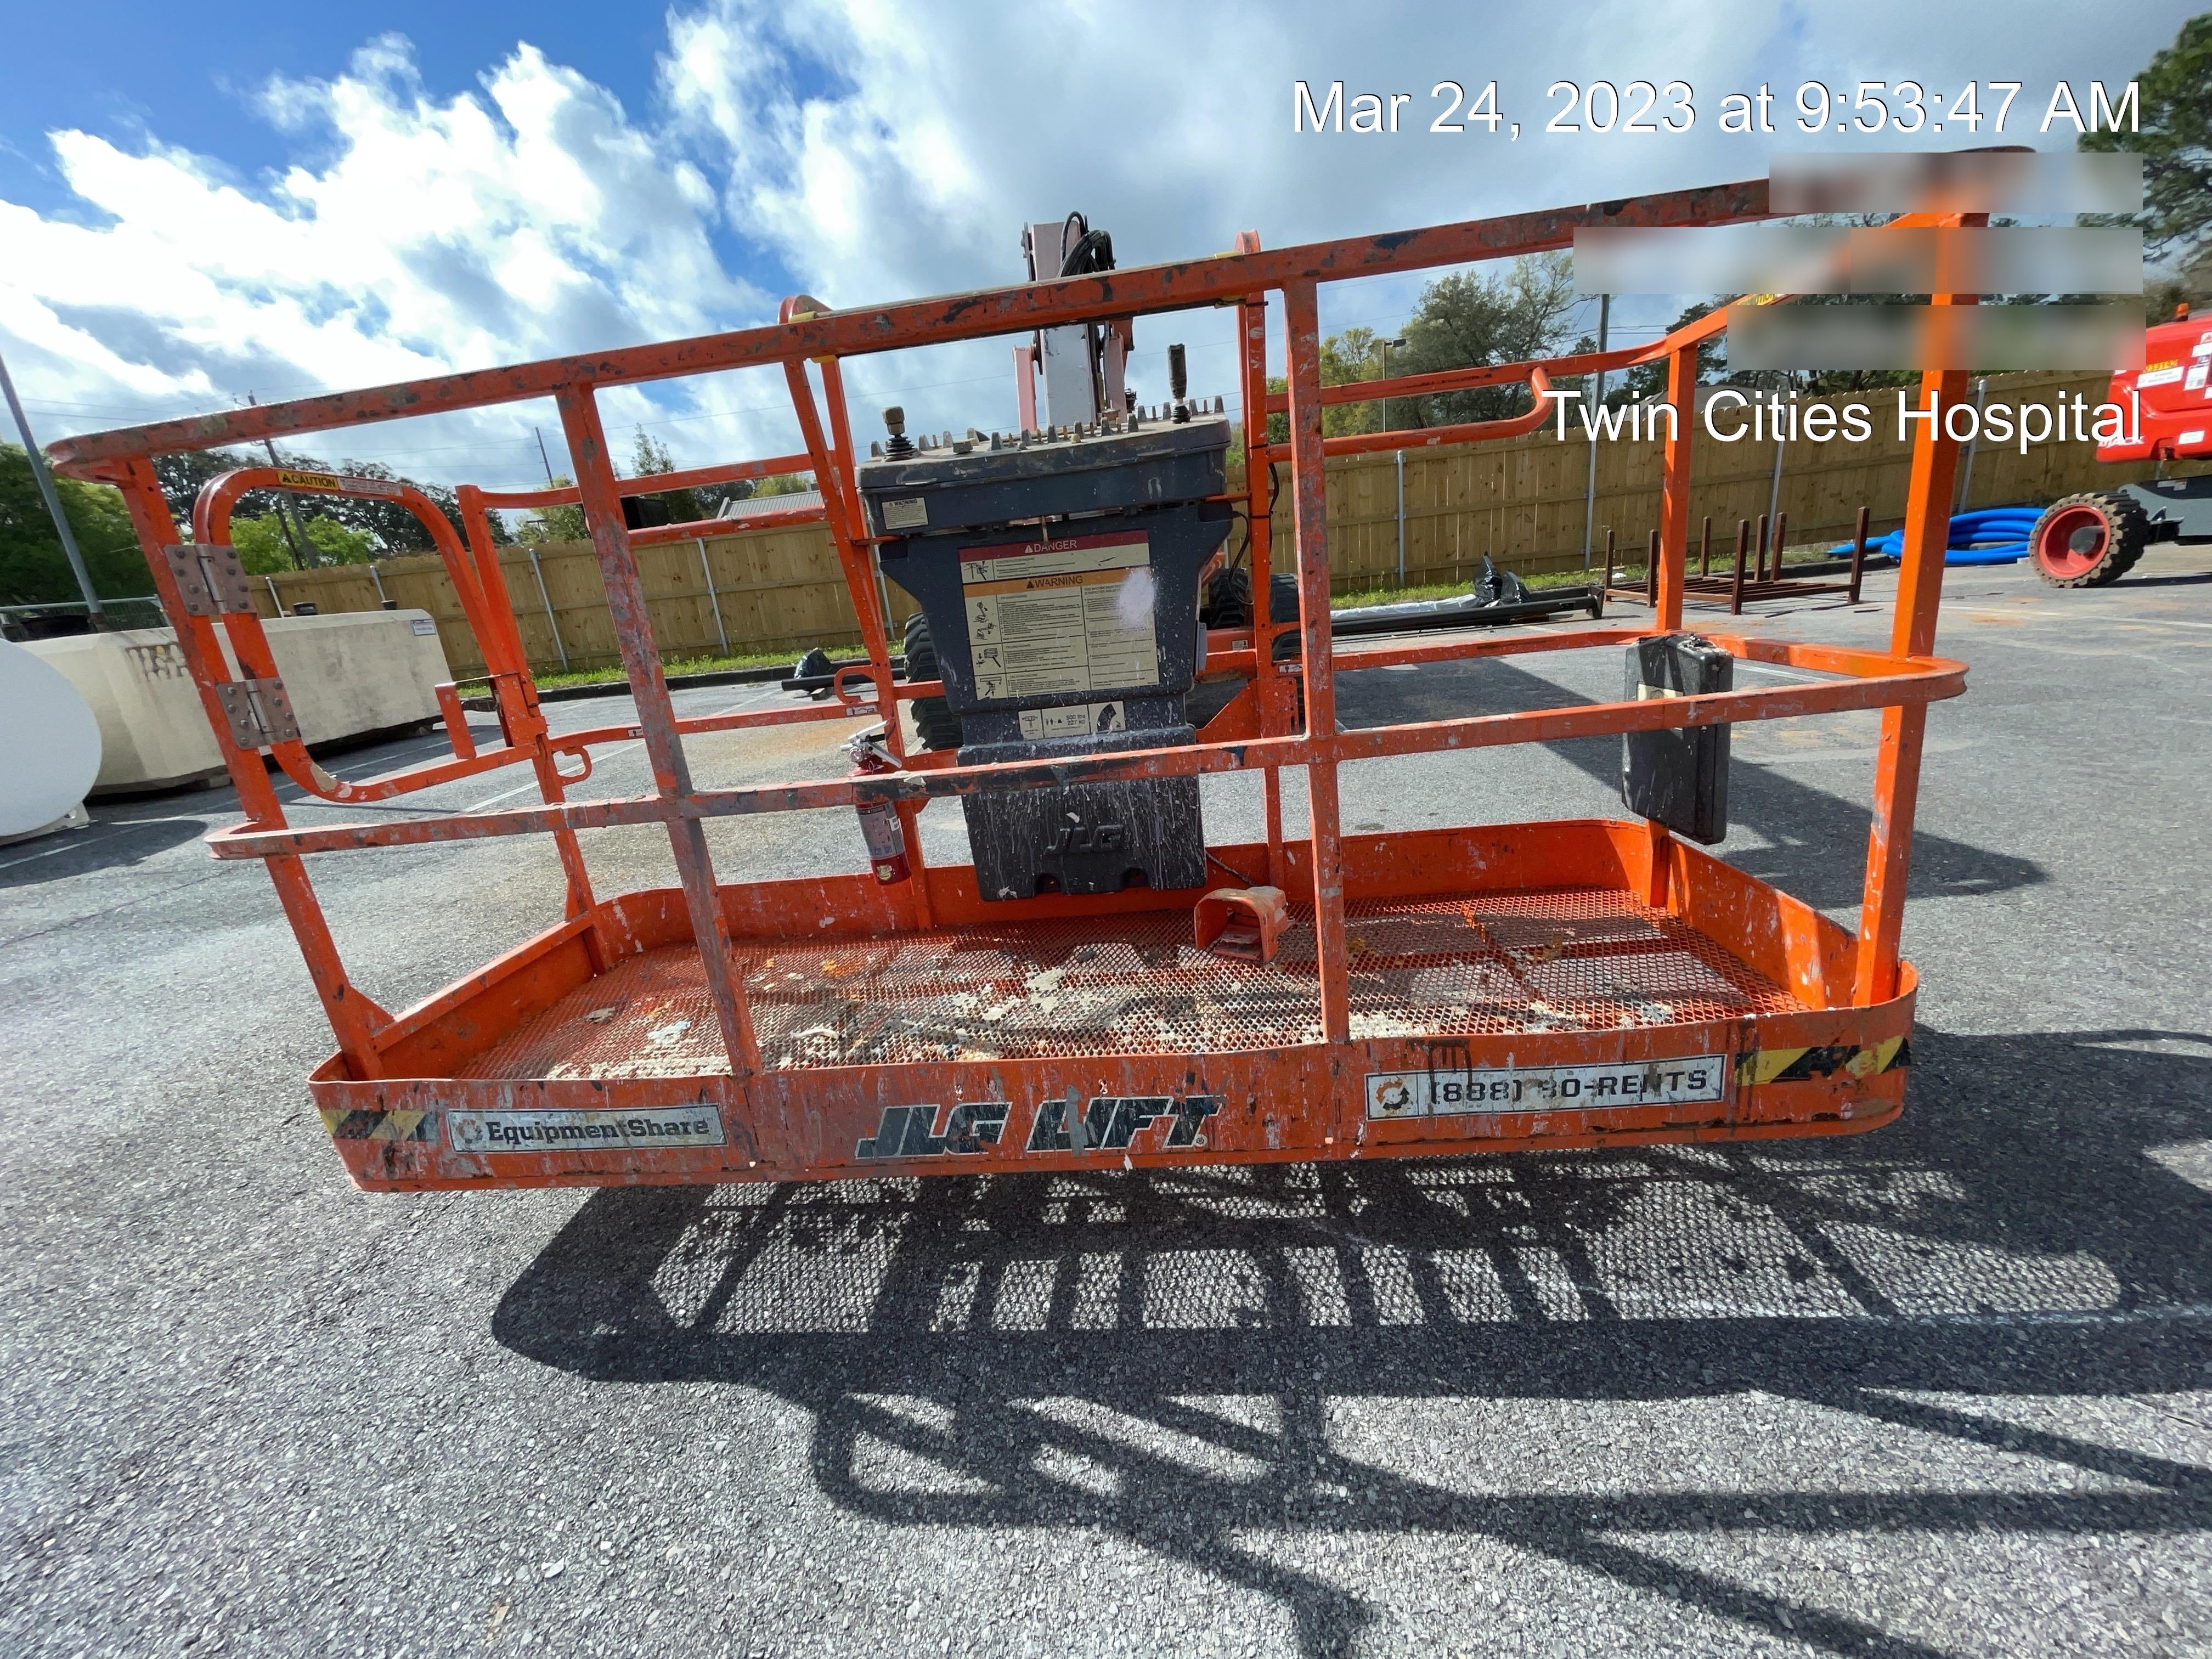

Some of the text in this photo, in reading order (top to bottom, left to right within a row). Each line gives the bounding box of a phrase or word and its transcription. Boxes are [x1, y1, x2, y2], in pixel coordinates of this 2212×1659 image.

[291, 475, 337, 488] CAUTION
[1034, 540, 1077, 552] DANGER
[1035, 575, 1083, 588] WARNING
[486, 1119, 709, 1146] EquipmentShare
[855, 1102, 1012, 1159] JLG
